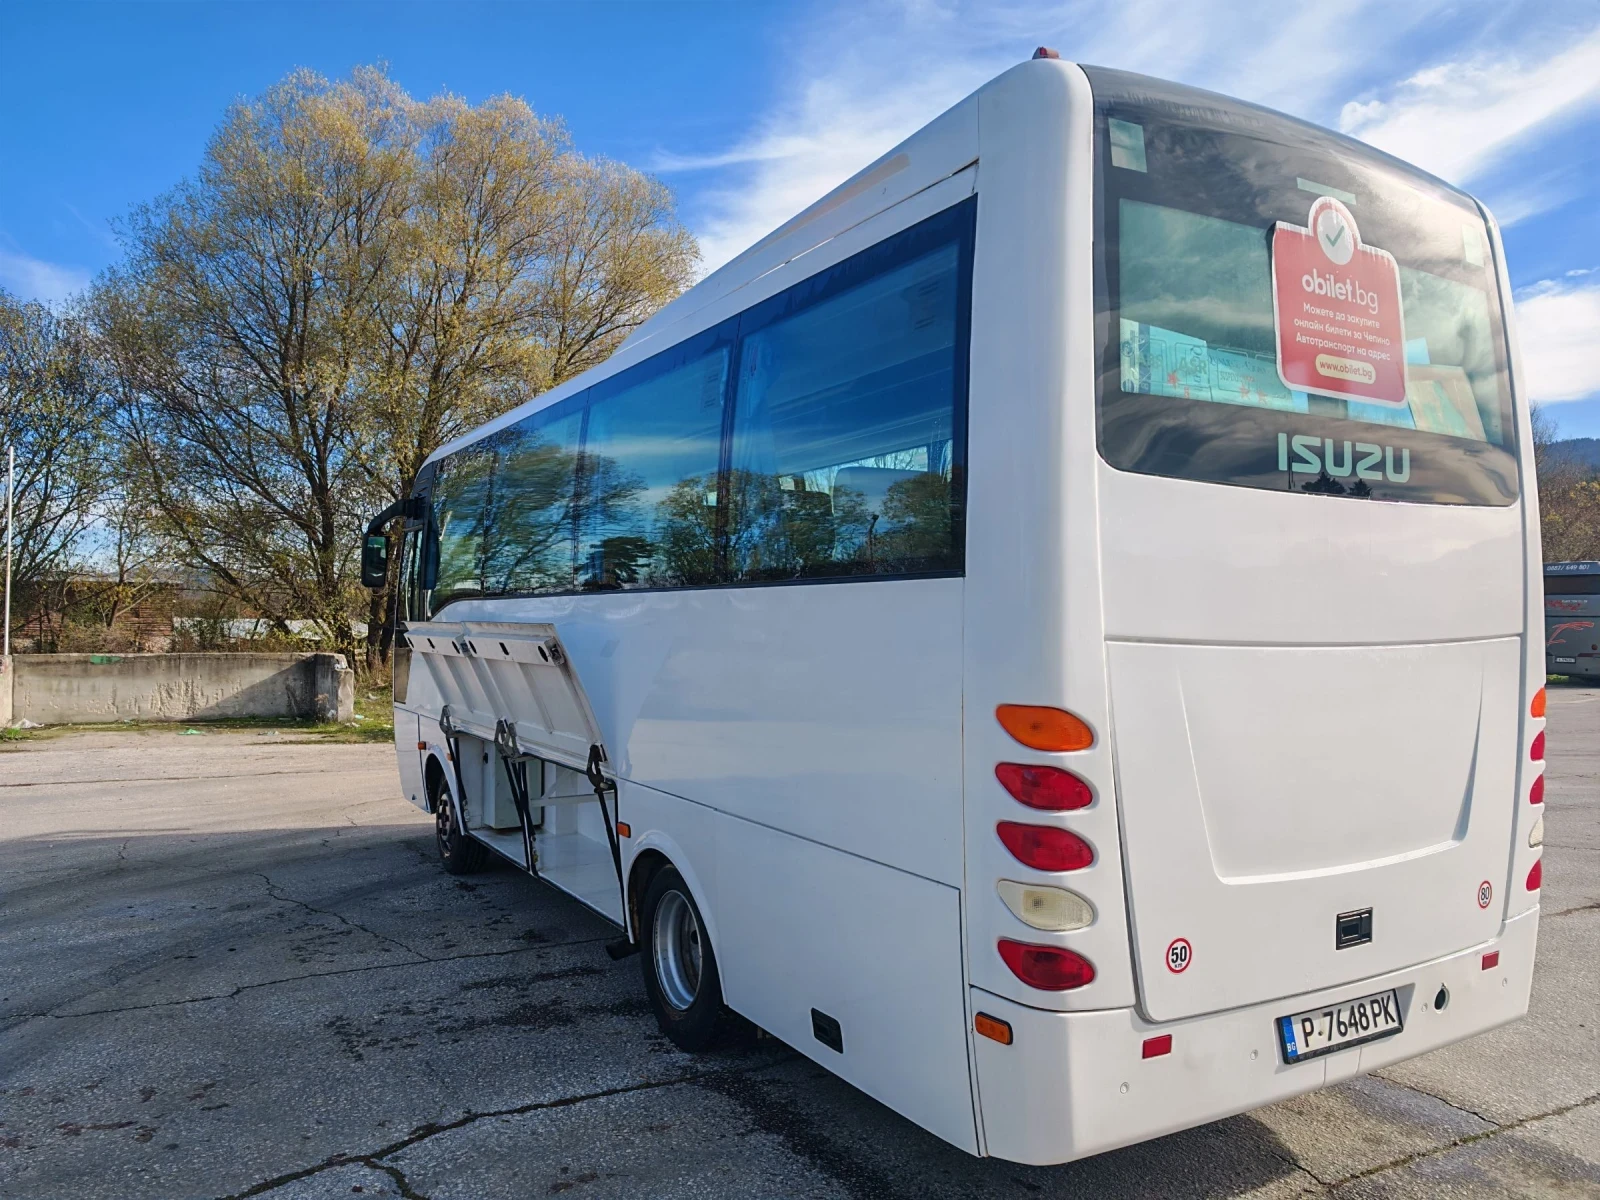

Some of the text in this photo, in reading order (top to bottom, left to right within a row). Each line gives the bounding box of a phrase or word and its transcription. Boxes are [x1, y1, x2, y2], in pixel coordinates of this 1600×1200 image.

[1302, 268, 1378, 314] obilet.bg
[1303, 302, 1380, 329] Можете да закупите
[1294, 318, 1391, 346] онлайн билети за Чепино
[1296, 332, 1391, 361] Автотранспорт на адрес
[1320, 361, 1373, 380] www.obilet.bg
[1278, 432, 1411, 483] ISUZU
[1481, 886, 1490, 901] 80
[1171, 945, 1187, 964] 50
[1287, 1042, 1297, 1053] BG
